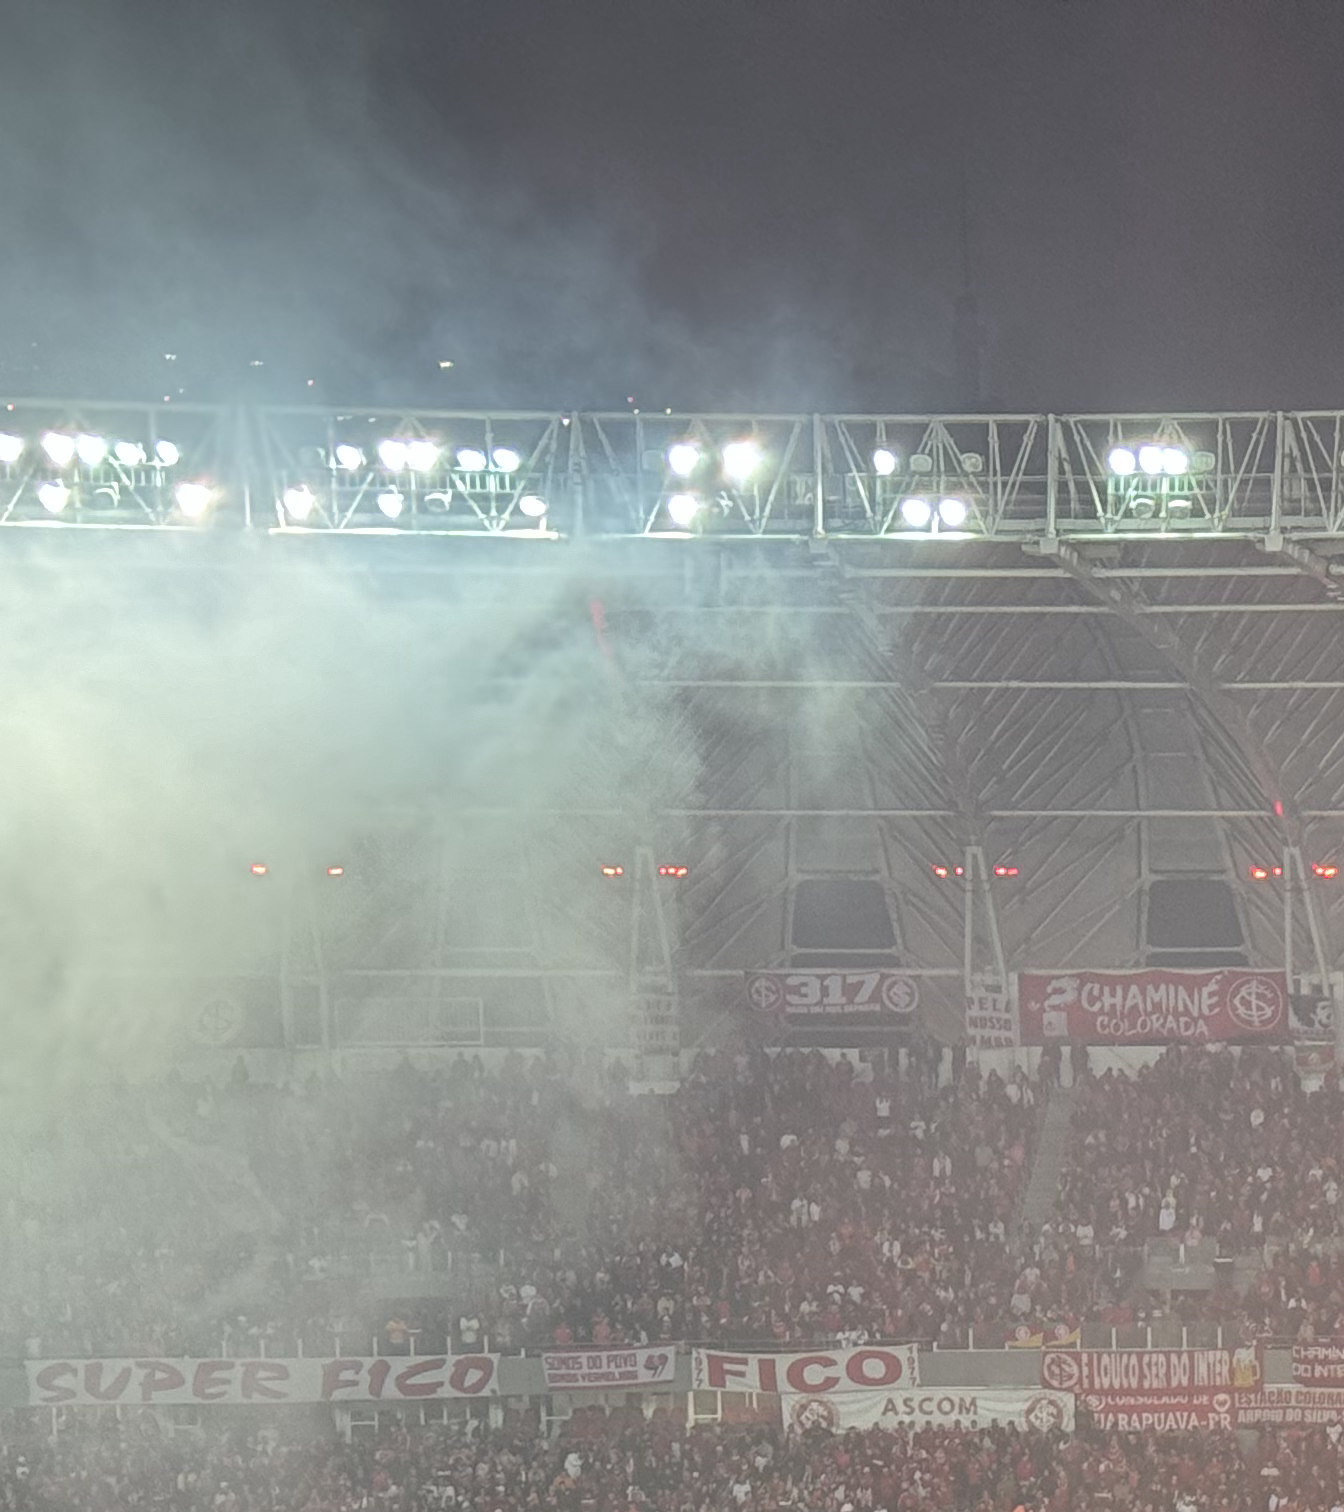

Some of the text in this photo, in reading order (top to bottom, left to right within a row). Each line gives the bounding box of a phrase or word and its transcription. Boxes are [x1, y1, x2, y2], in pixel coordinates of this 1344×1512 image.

[786, 972, 880, 1005] 317
[1081, 973, 1224, 1017] CHAMINÉ
[1096, 1012, 1209, 1037] COLORADA
[36, 1354, 495, 1402] SUPER FICO
[705, 1349, 903, 1393] FICO
[1093, 1352, 1139, 1390] LOUCO
[1142, 1353, 1168, 1389] SER
[1170, 1352, 1190, 1388] DO
[1194, 1350, 1232, 1387] INTER
[881, 1396, 979, 1418] ASCOM
[1094, 1411, 1233, 1431] UARAPUAVA-PR
